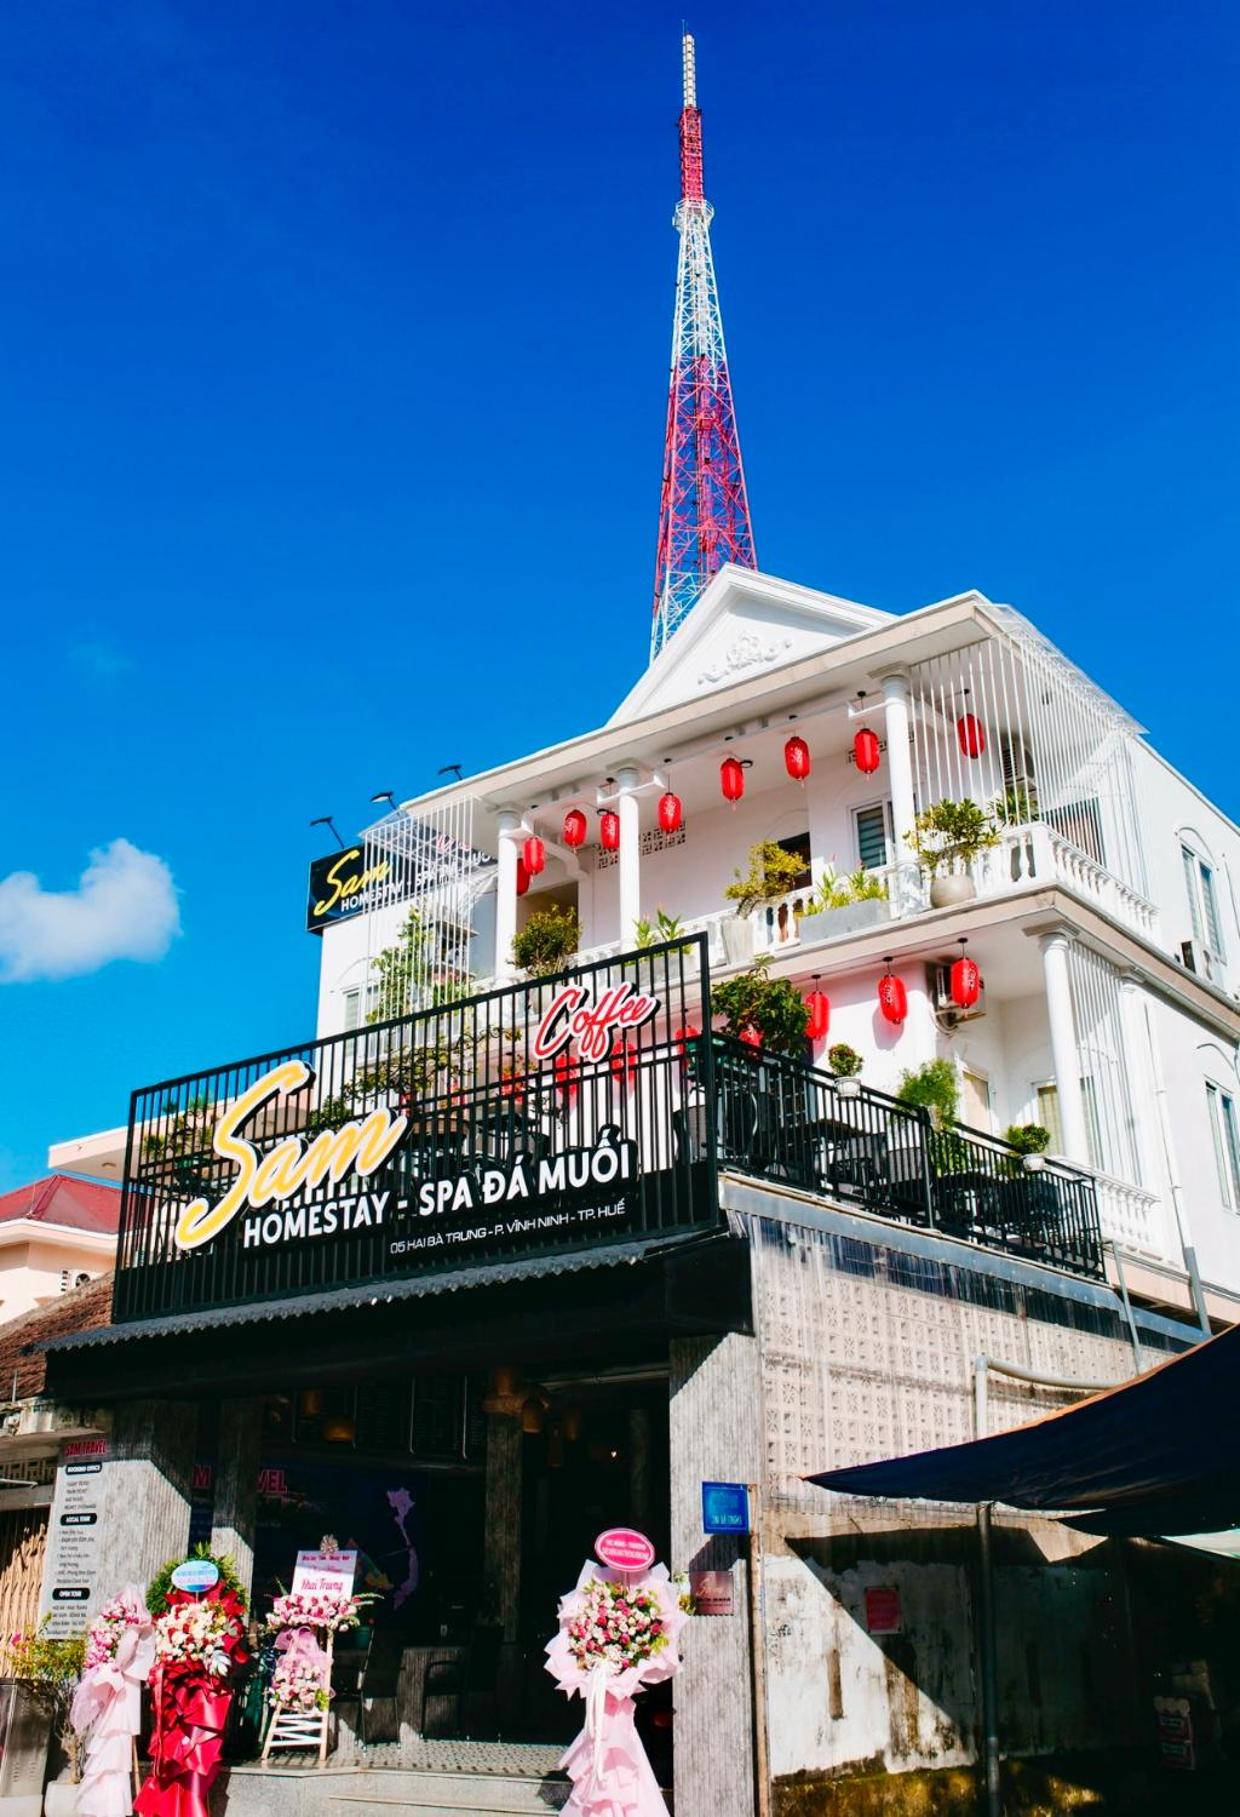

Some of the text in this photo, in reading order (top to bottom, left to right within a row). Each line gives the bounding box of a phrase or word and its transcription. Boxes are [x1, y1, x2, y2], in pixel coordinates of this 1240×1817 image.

[313, 849, 391, 916] Sam
[533, 981, 659, 1063] Coffee
[174, 1059, 408, 1249] Sam
[243, 1190, 391, 1249] HOMESTAY
[419, 1176, 474, 1217] SPA
[482, 1154, 530, 1205] ĐÁ
[538, 1128, 630, 1195] MUỐI
[389, 1241, 406, 1255] 05
[407, 1237, 427, 1252] HAI
[427, 1232, 445, 1247] BÀ
[537, 1211, 570, 1230] NINH
[597, 1197, 626, 1218] HUẾ
